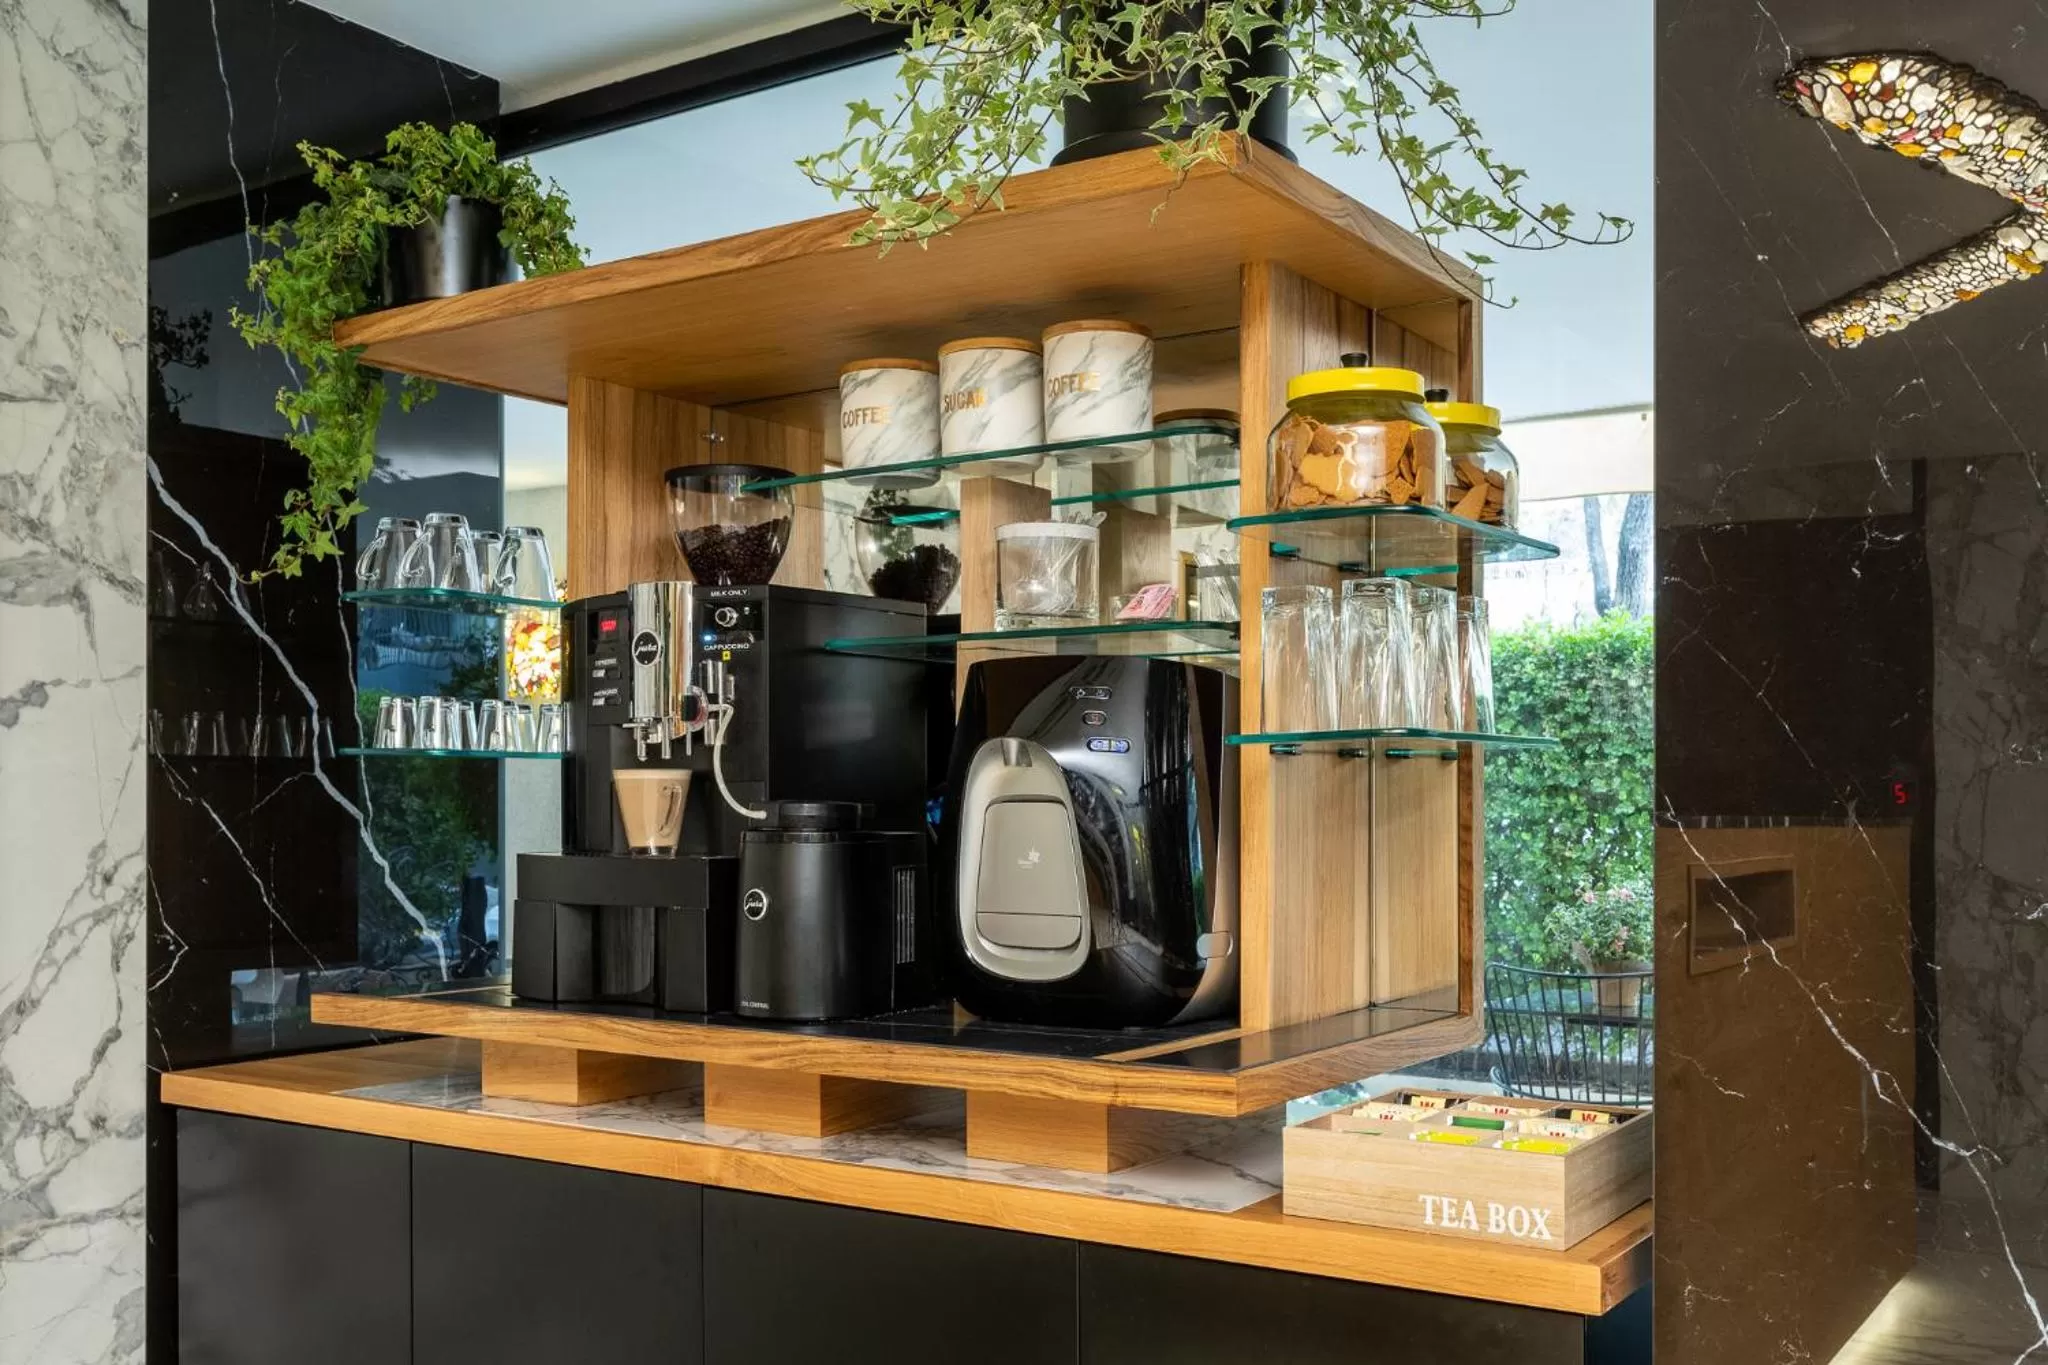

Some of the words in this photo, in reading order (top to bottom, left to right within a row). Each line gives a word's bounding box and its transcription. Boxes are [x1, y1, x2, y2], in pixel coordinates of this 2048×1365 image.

[1048, 371, 1101, 398] COFFEE
[943, 388, 987, 411] SUGAR
[842, 405, 891, 429] COFFEE
[704, 643, 750, 651] CAPPUCCINO
[1418, 1193, 1479, 1233] TEA
[1487, 1201, 1553, 1241] BOX
